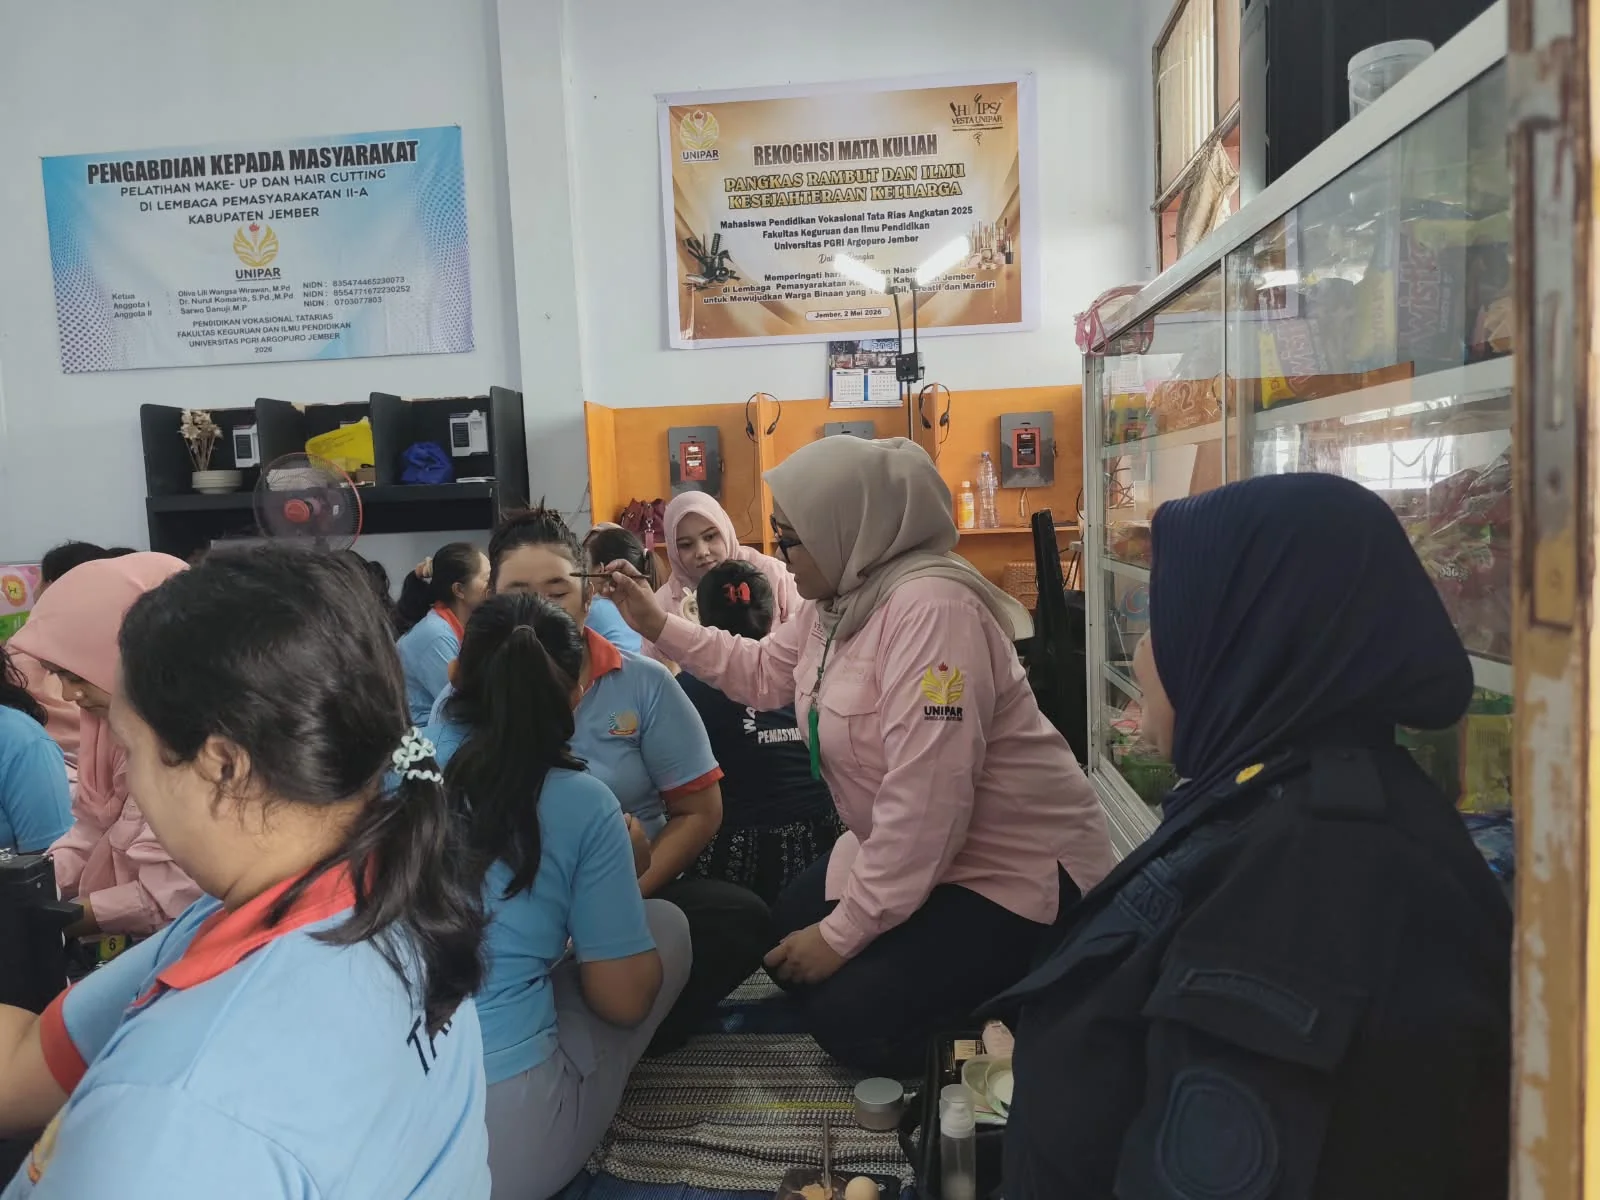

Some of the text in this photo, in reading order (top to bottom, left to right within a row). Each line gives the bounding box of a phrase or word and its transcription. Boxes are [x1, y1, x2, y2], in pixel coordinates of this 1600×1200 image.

[952, 113, 1003, 125] VESTA UNIPAR
[682, 149, 720, 161] UNIPAR
[753, 133, 938, 166] REKOGNISI MATA KULIAH
[87, 141, 418, 184] PENGABDIAN KEPADA MASYARAKAT
[120, 168, 386, 197] PELATIHAN MAKE- UP DAN HAIR CUTTING
[724, 162, 965, 192] PANGKAS RAMBUT DAN ILMU
[140, 187, 369, 212] DI LEMBAGA PEMASYARAKATAN II-A
[728, 181, 963, 210] KESEJAHTERAAN KELUARGA
[189, 207, 320, 225] KABUPATEN JEMBER
[720, 205, 973, 229] Mahasiswa Pendidikan Vokasional Tata Rias Angkatan 2025
[762, 221, 930, 239] Fakultas Keguruan dan Ilmu Pendidikan
[774, 235, 919, 251] Universitas PGRI Argopuro Jember
[235, 267, 281, 280] UNIPAR
[764, 272, 822, 282] Memperingati
[112, 293, 136, 301] Ketua
[178, 289, 196, 298] Oliva
[197, 288, 208, 297] Lili
[209, 287, 238, 297] Wangsa
[272, 284, 291, 292] M.Pd
[303, 281, 323, 289] NIDN
[729, 294, 783, 303] Mewujudkan
[785, 292, 812, 300] Warga
[814, 289, 844, 298] Binaan
[846, 289, 866, 297] yang
[917, 284, 942, 292] reatif
[944, 283, 962, 291] dan
[962, 280, 996, 289] Mandiri
[732, 284, 771, 295] Lembaga
[776, 280, 847, 291] Pemasyarakatan
[942, 273, 975, 281] Jember
[113, 302, 146, 311] Anggota
[179, 298, 190, 306] Dr.
[191, 296, 213, 305] Nurul
[303, 290, 324, 299] NIDN
[114, 311, 146, 320] Anggota
[180, 306, 205, 315] Sarwo
[303, 299, 325, 308] NIDN
[192, 313, 334, 328] PENDIDIKAN VOKASIONAL TATARIAS
[814, 311, 843, 319] Jember,
[177, 321, 351, 339] FAKULTAS KEGURUAN DAN ILMU PENDIDIKAN
[189, 332, 340, 348] UNIVERSITAS PGRI ARGOPURO JEMBER
[924, 705, 963, 717] UNIPAR
